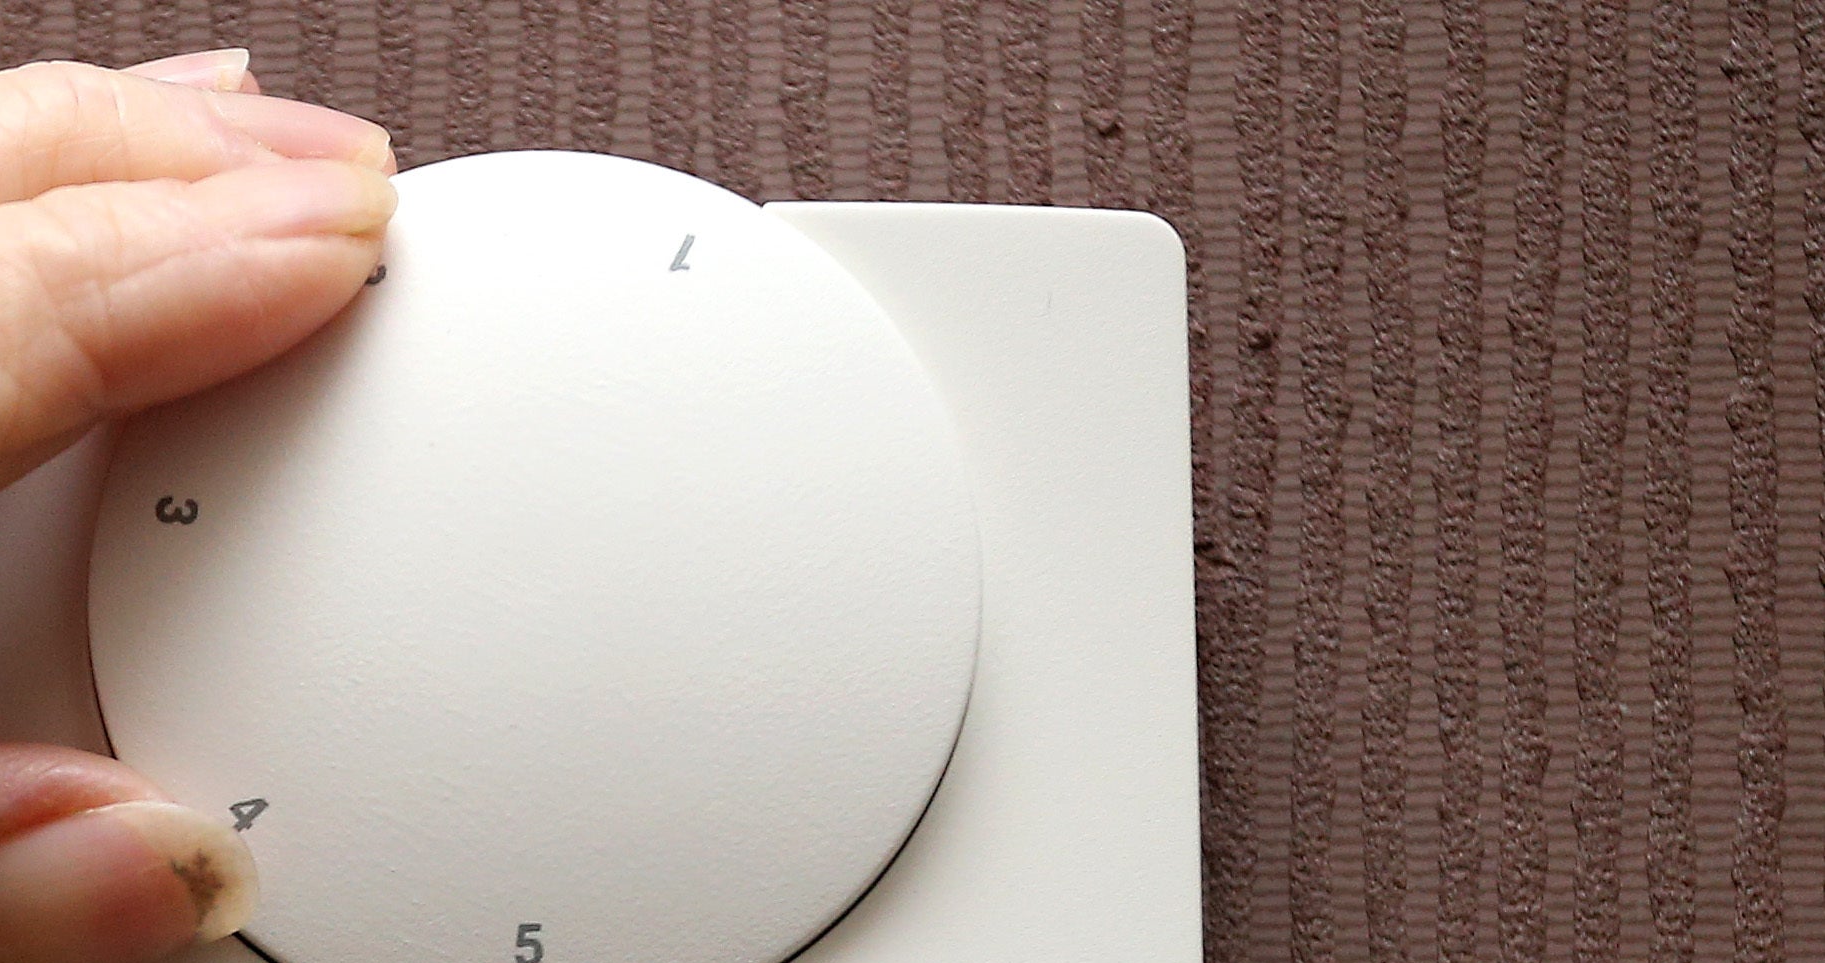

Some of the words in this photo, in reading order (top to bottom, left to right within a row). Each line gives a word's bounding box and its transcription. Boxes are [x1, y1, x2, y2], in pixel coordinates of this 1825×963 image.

[669, 233, 695, 272] 1
[155, 495, 199, 525] 3
[229, 798, 269, 832] 4
